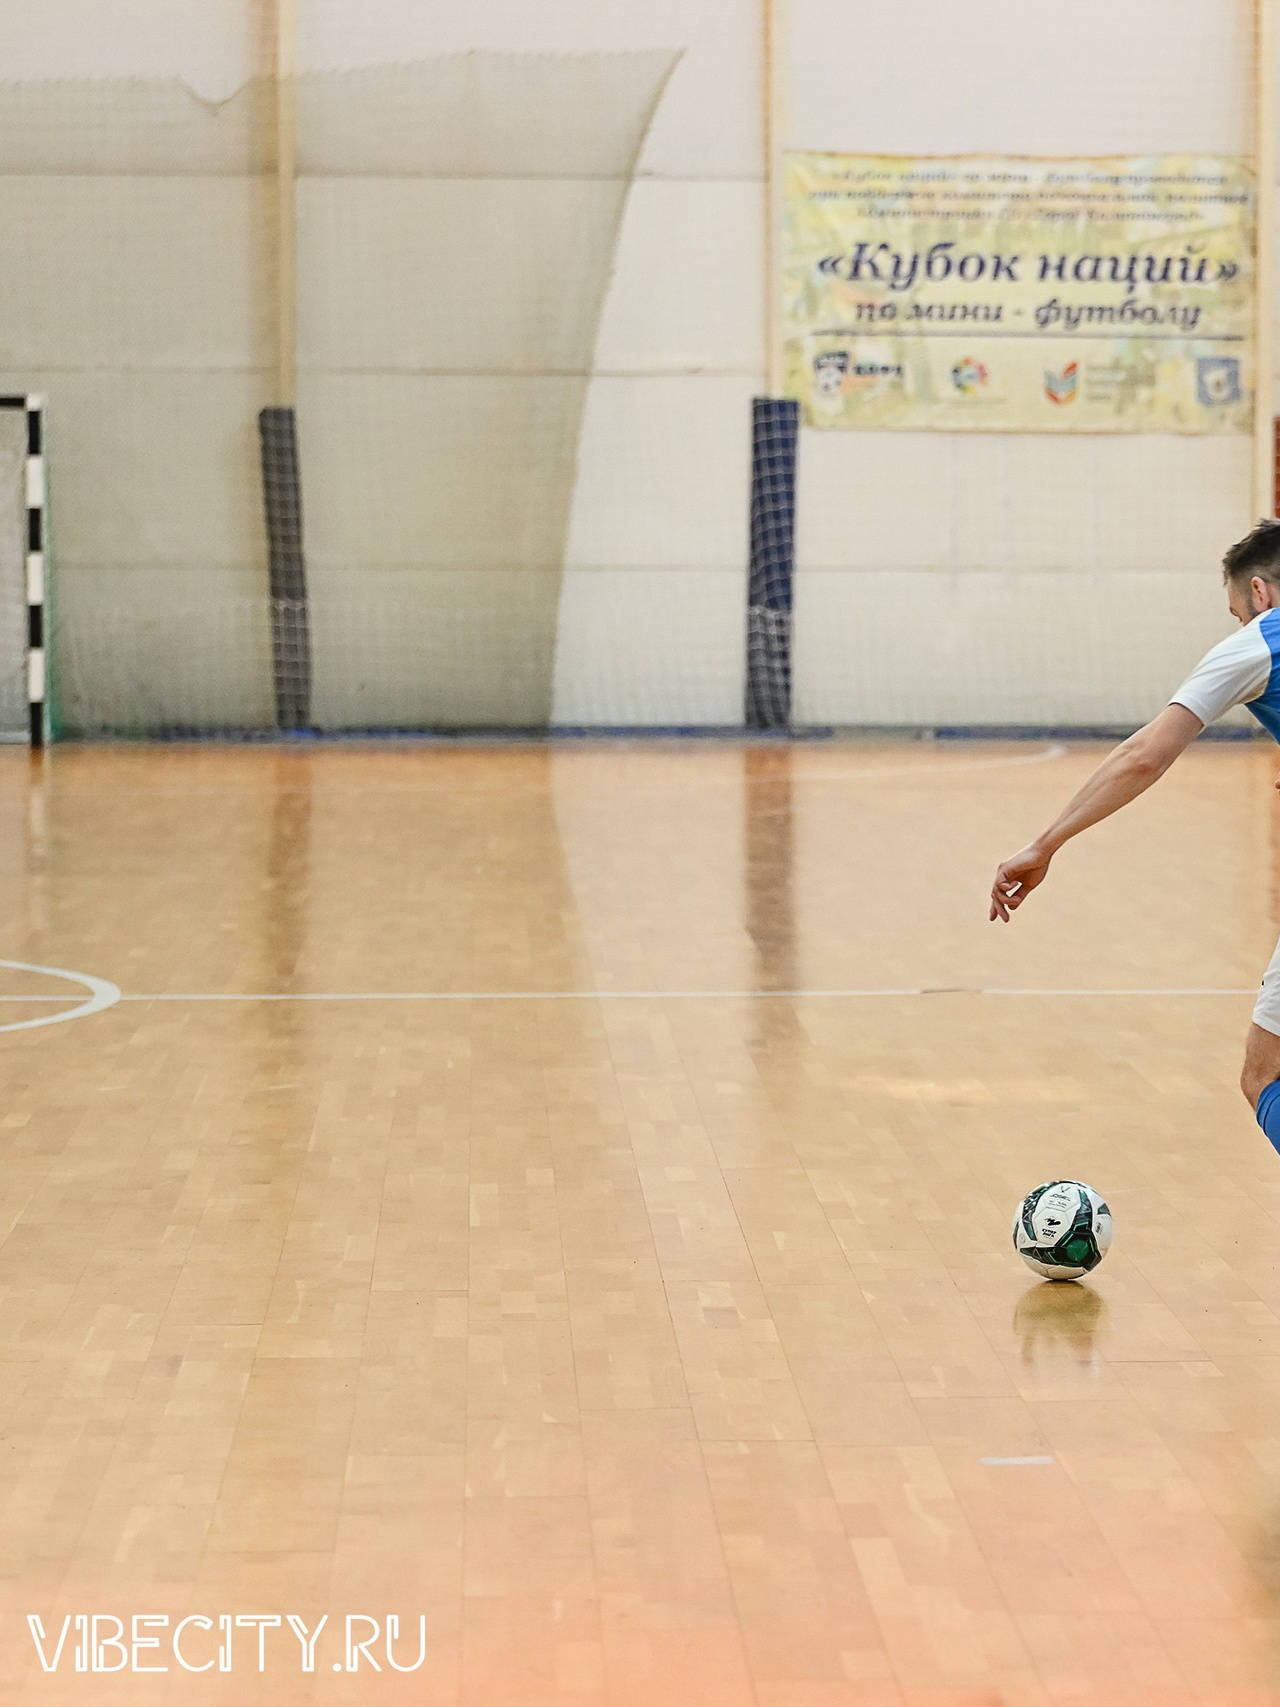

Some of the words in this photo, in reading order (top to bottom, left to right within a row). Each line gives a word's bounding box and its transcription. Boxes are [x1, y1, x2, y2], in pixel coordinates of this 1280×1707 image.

[817, 242, 1018, 291] «Кубок
[1038, 244, 1240, 291] наций»
[855, 301, 897, 322] по
[905, 302, 1003, 323] мини
[1034, 298, 1203, 331] футболу
